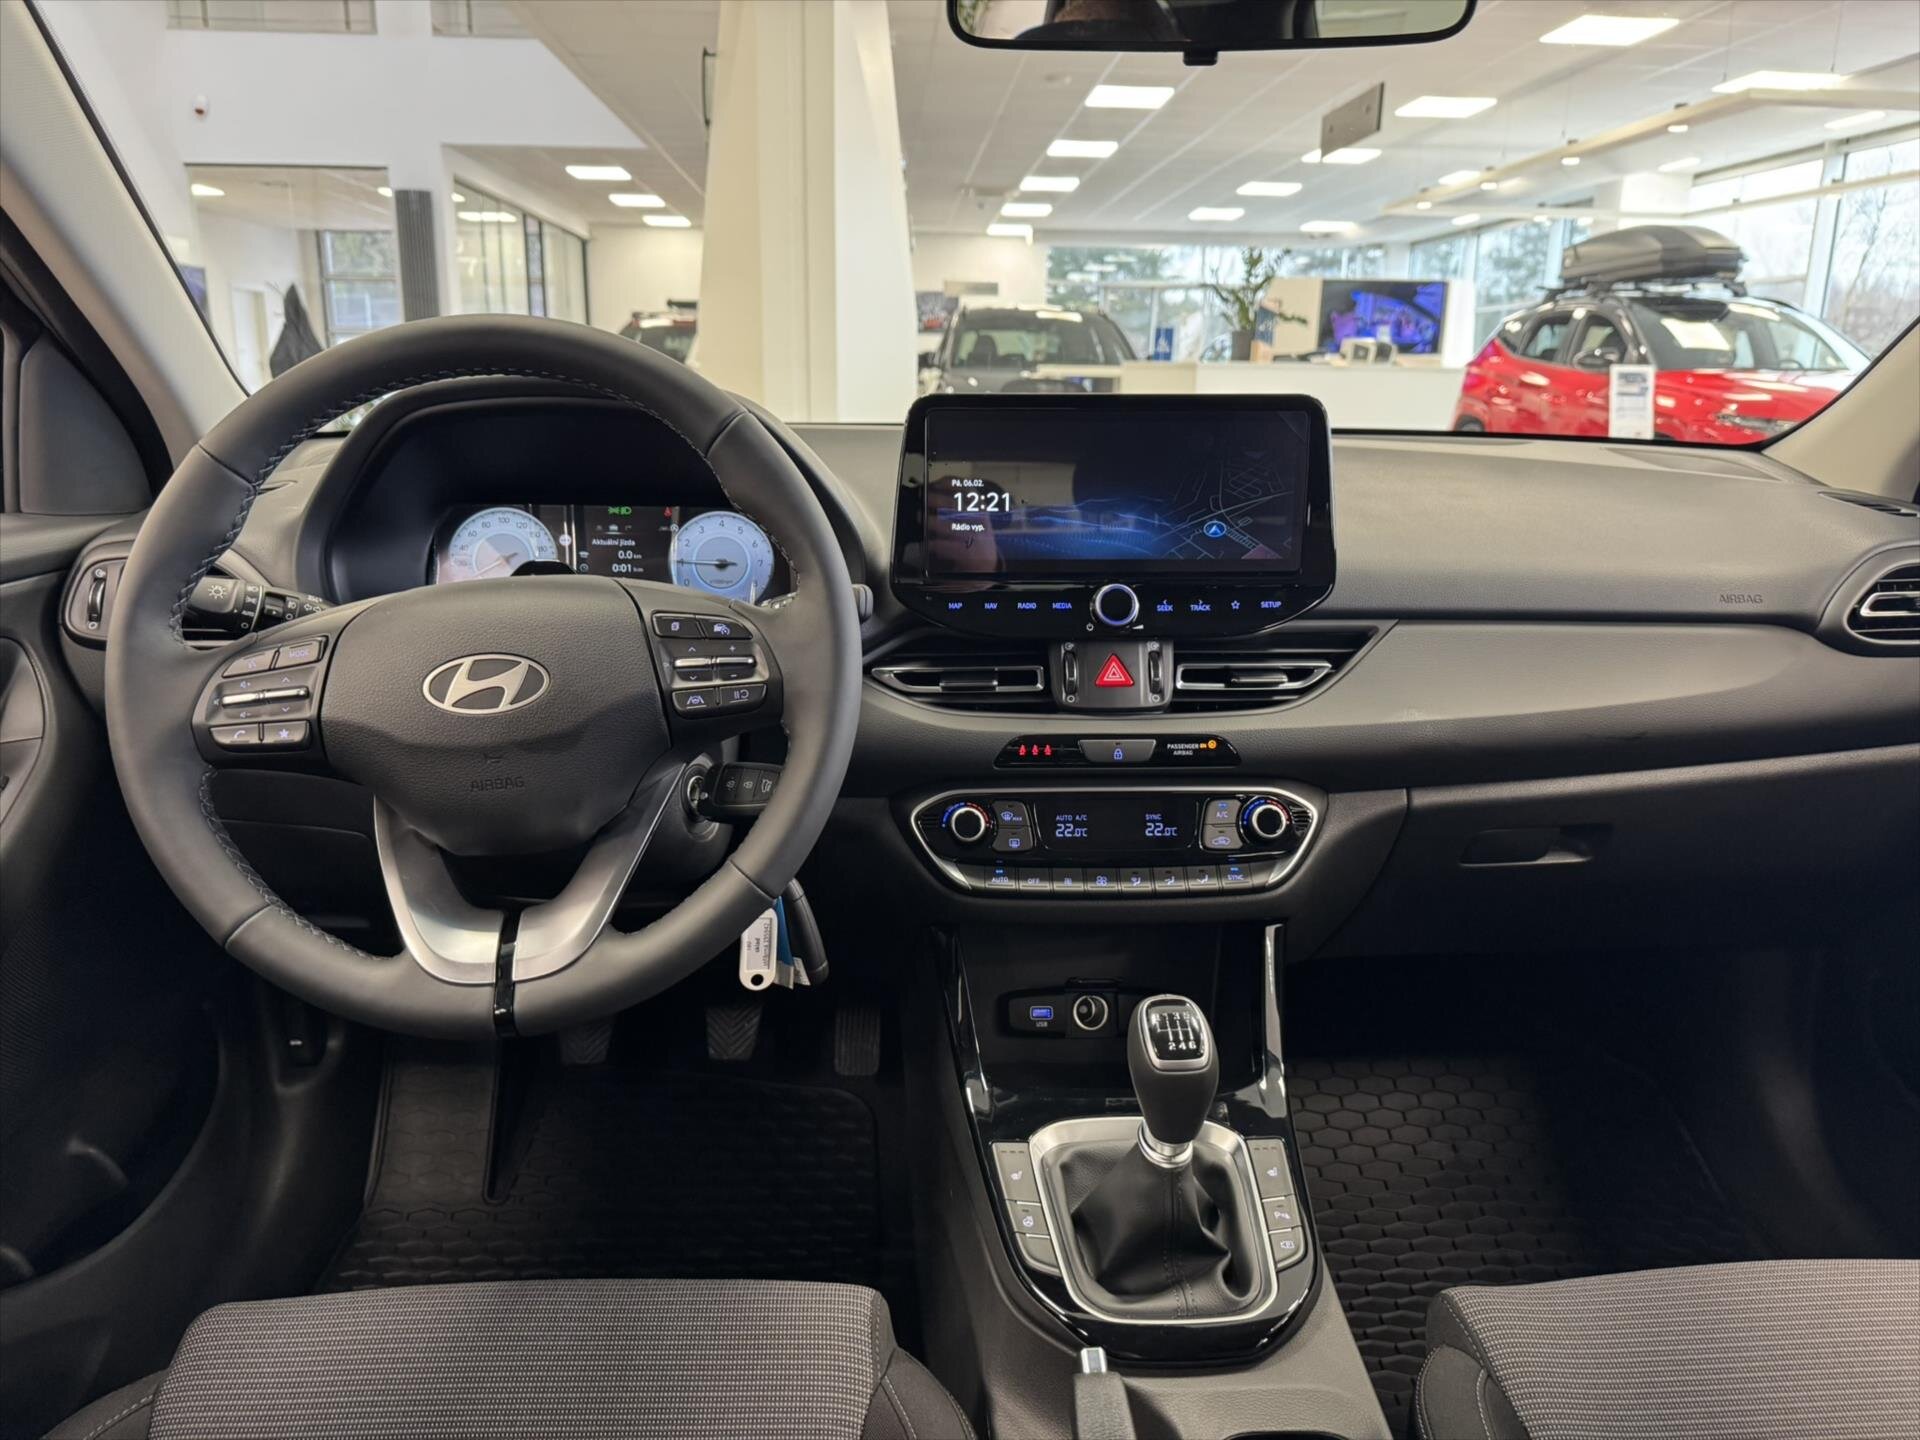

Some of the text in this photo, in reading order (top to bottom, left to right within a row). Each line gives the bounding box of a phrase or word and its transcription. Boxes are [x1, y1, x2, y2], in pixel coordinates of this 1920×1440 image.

[963, 479, 984, 487] 06.02.
[954, 492, 1010, 512] 12:21
[482, 521, 491, 529] 80
[516, 521, 528, 529] 120
[719, 520, 725, 528] 4
[952, 522, 985, 533] Rádio vyp.
[699, 525, 705, 534] 3
[738, 526, 744, 535] 5
[592, 538, 636, 547] Aktuální jízda
[685, 539, 691, 547] 2
[618, 550, 633, 560] 0.0
[612, 563, 632, 573] 0:01
[684, 579, 690, 587] 0
[1719, 593, 1764, 604] AIRBAG
[1157, 604, 1173, 612] SEEK
[1260, 600, 1281, 609] SETUP
[470, 775, 525, 792] AIRBAG
[1145, 813, 1162, 821] SYNC
[1172, 1012, 1180, 1020] 3
[1168, 1041, 1197, 1050] 2 4 6
